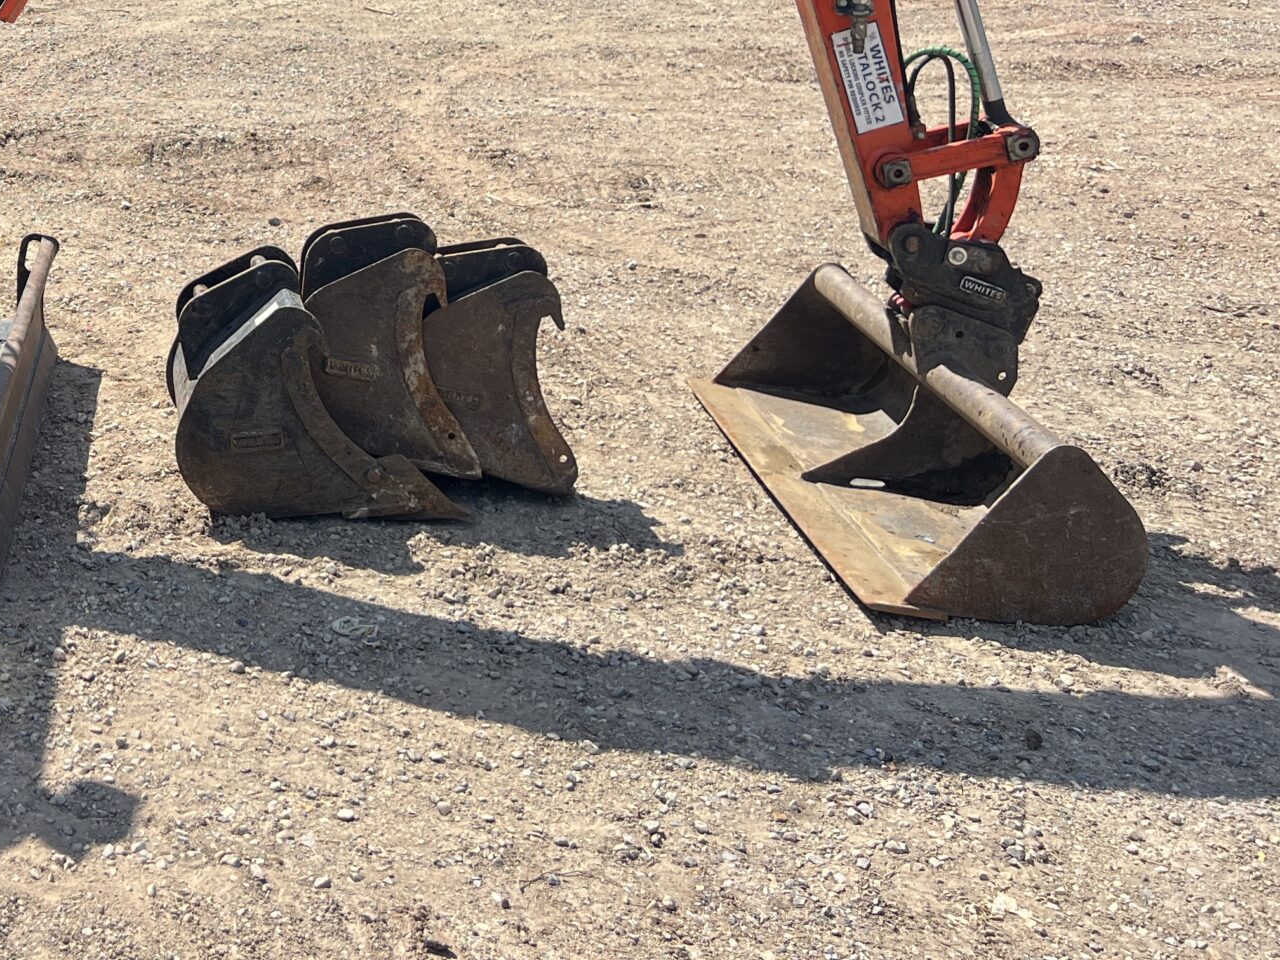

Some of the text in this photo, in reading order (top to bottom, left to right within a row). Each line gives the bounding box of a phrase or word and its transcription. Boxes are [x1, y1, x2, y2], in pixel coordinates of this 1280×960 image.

[840, 58, 851, 79] SAFETY
[846, 78, 854, 90] PIN
[858, 52, 885, 124] TALOCK 2
[870, 44, 895, 104] WHITES
[855, 81, 867, 106] COUPLER
[965, 281, 1002, 300] WHITES
